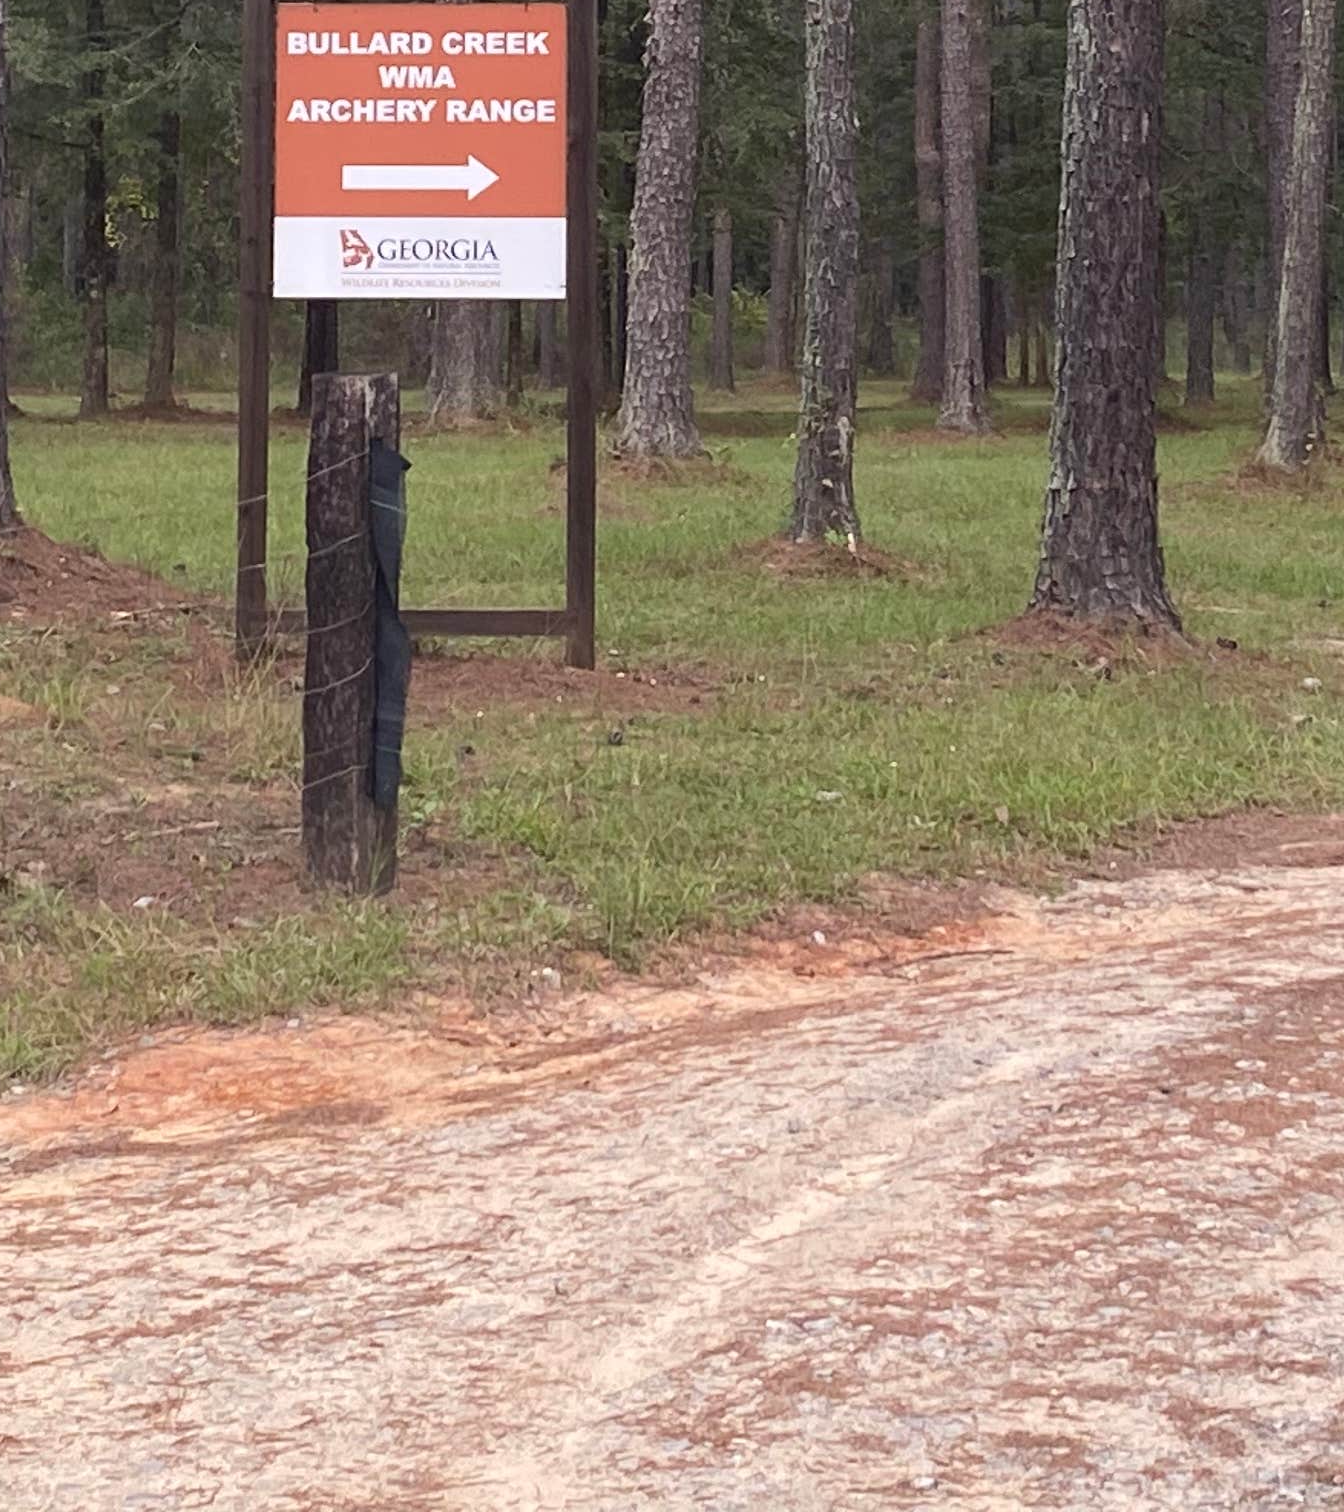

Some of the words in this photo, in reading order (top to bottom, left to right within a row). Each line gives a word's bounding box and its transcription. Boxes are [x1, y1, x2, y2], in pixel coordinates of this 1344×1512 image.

[287, 31, 432, 55] BULLARD
[441, 31, 549, 55] CREEK
[378, 65, 456, 88] WMA
[286, 99, 437, 122] ARCHERY
[446, 99, 556, 122] RANGE
[377, 238, 499, 261] GEORGIA
